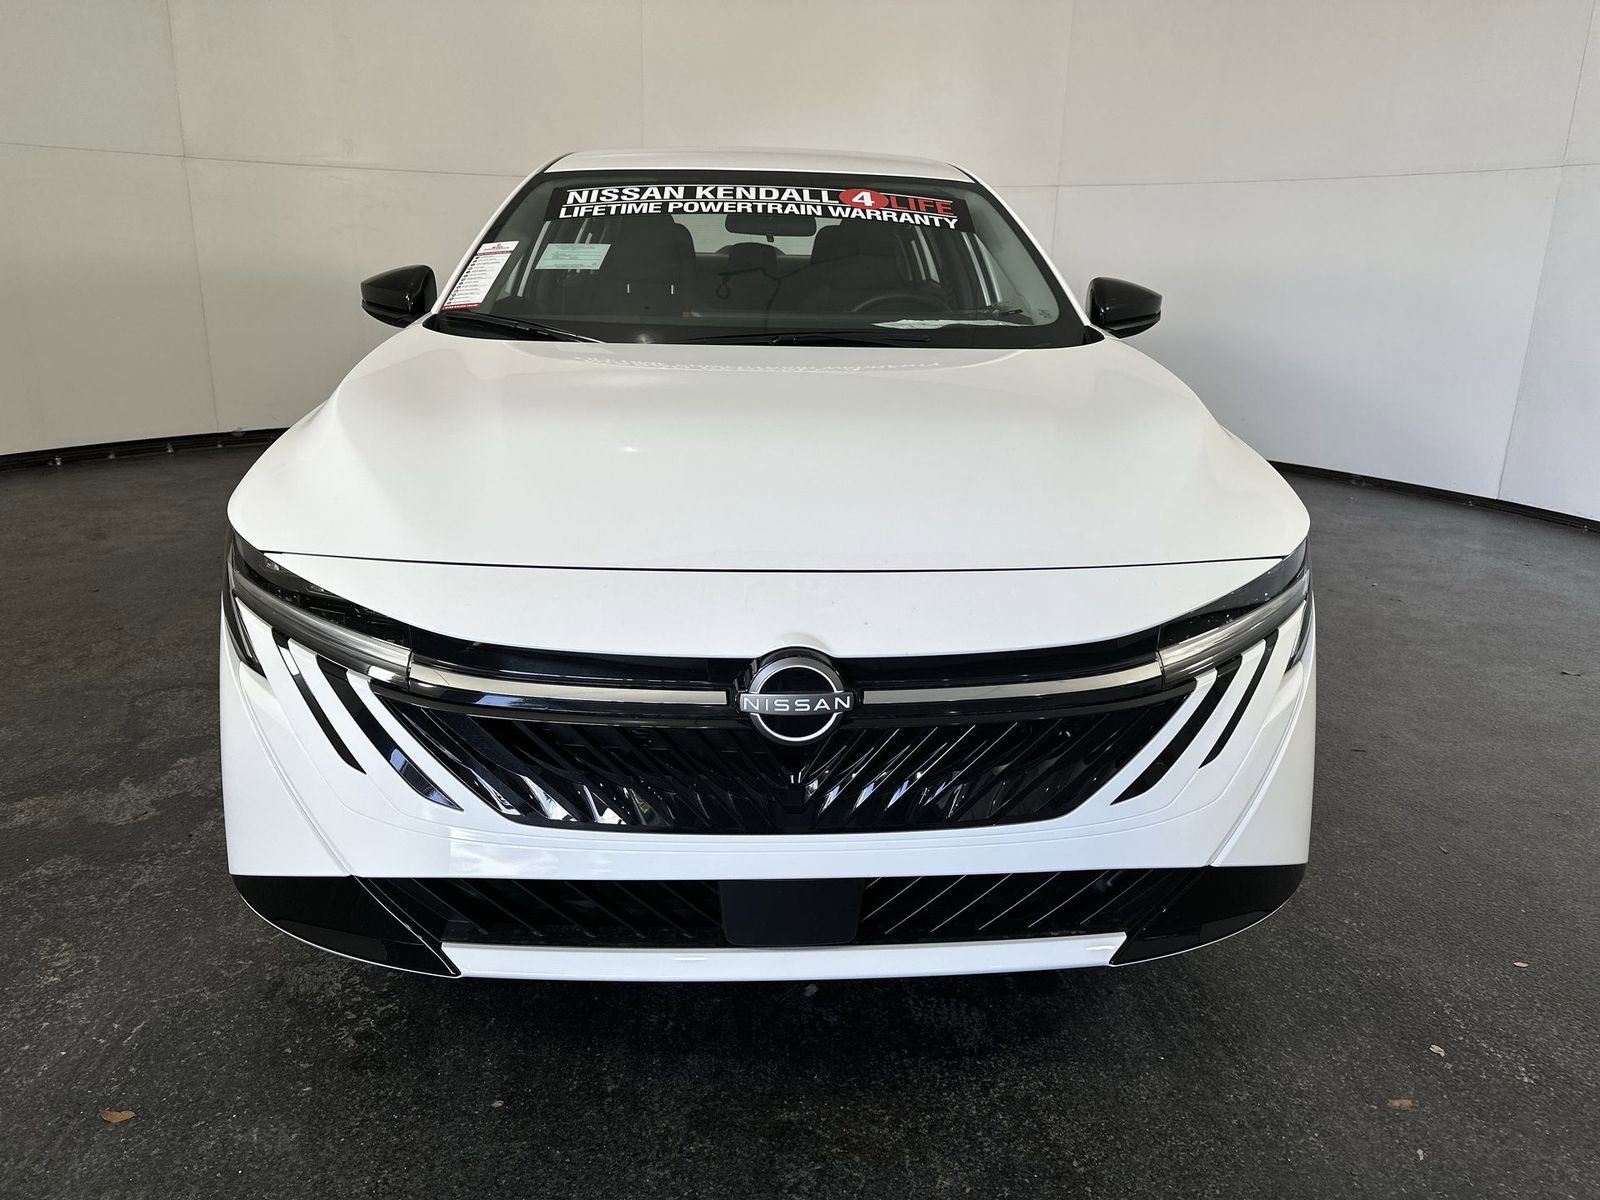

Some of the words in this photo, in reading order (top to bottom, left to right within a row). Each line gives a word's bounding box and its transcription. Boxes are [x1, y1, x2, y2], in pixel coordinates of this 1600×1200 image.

[559, 202, 662, 219] LIFETIME
[667, 201, 823, 217] POWERTRAIN
[828, 205, 958, 229] WARRANTY
[567, 187, 684, 205] NISSAN
[696, 187, 839, 203] KENDALL
[852, 191, 875, 207] 4
[889, 195, 954, 215] LIFE
[743, 696, 850, 711] NISSAN
